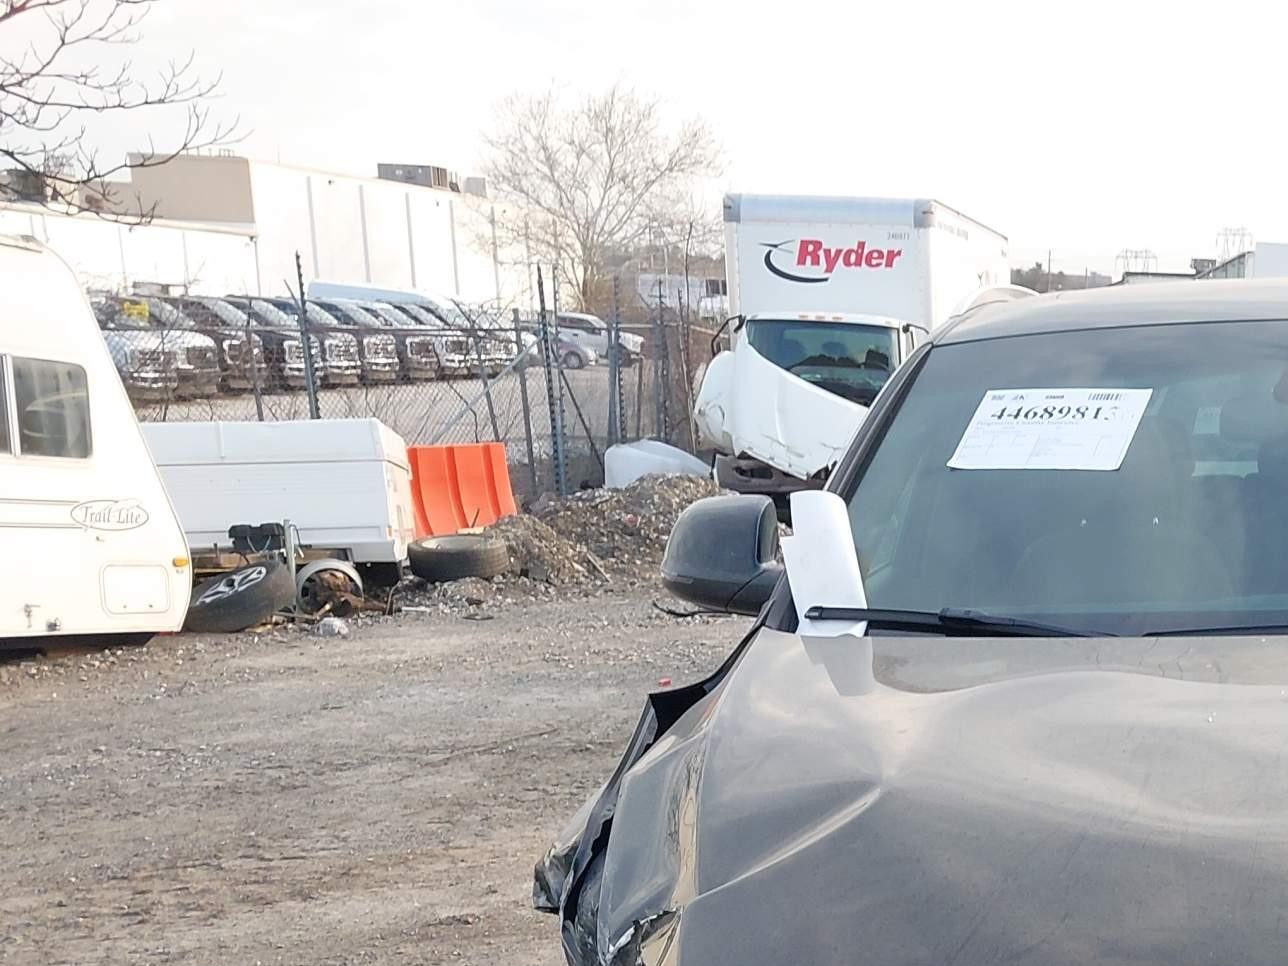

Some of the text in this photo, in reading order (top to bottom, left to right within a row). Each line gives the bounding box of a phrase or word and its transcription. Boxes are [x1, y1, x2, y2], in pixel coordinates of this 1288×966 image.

[797, 239, 902, 273] Ryder
[80, 505, 141, 524] Trail Lite
